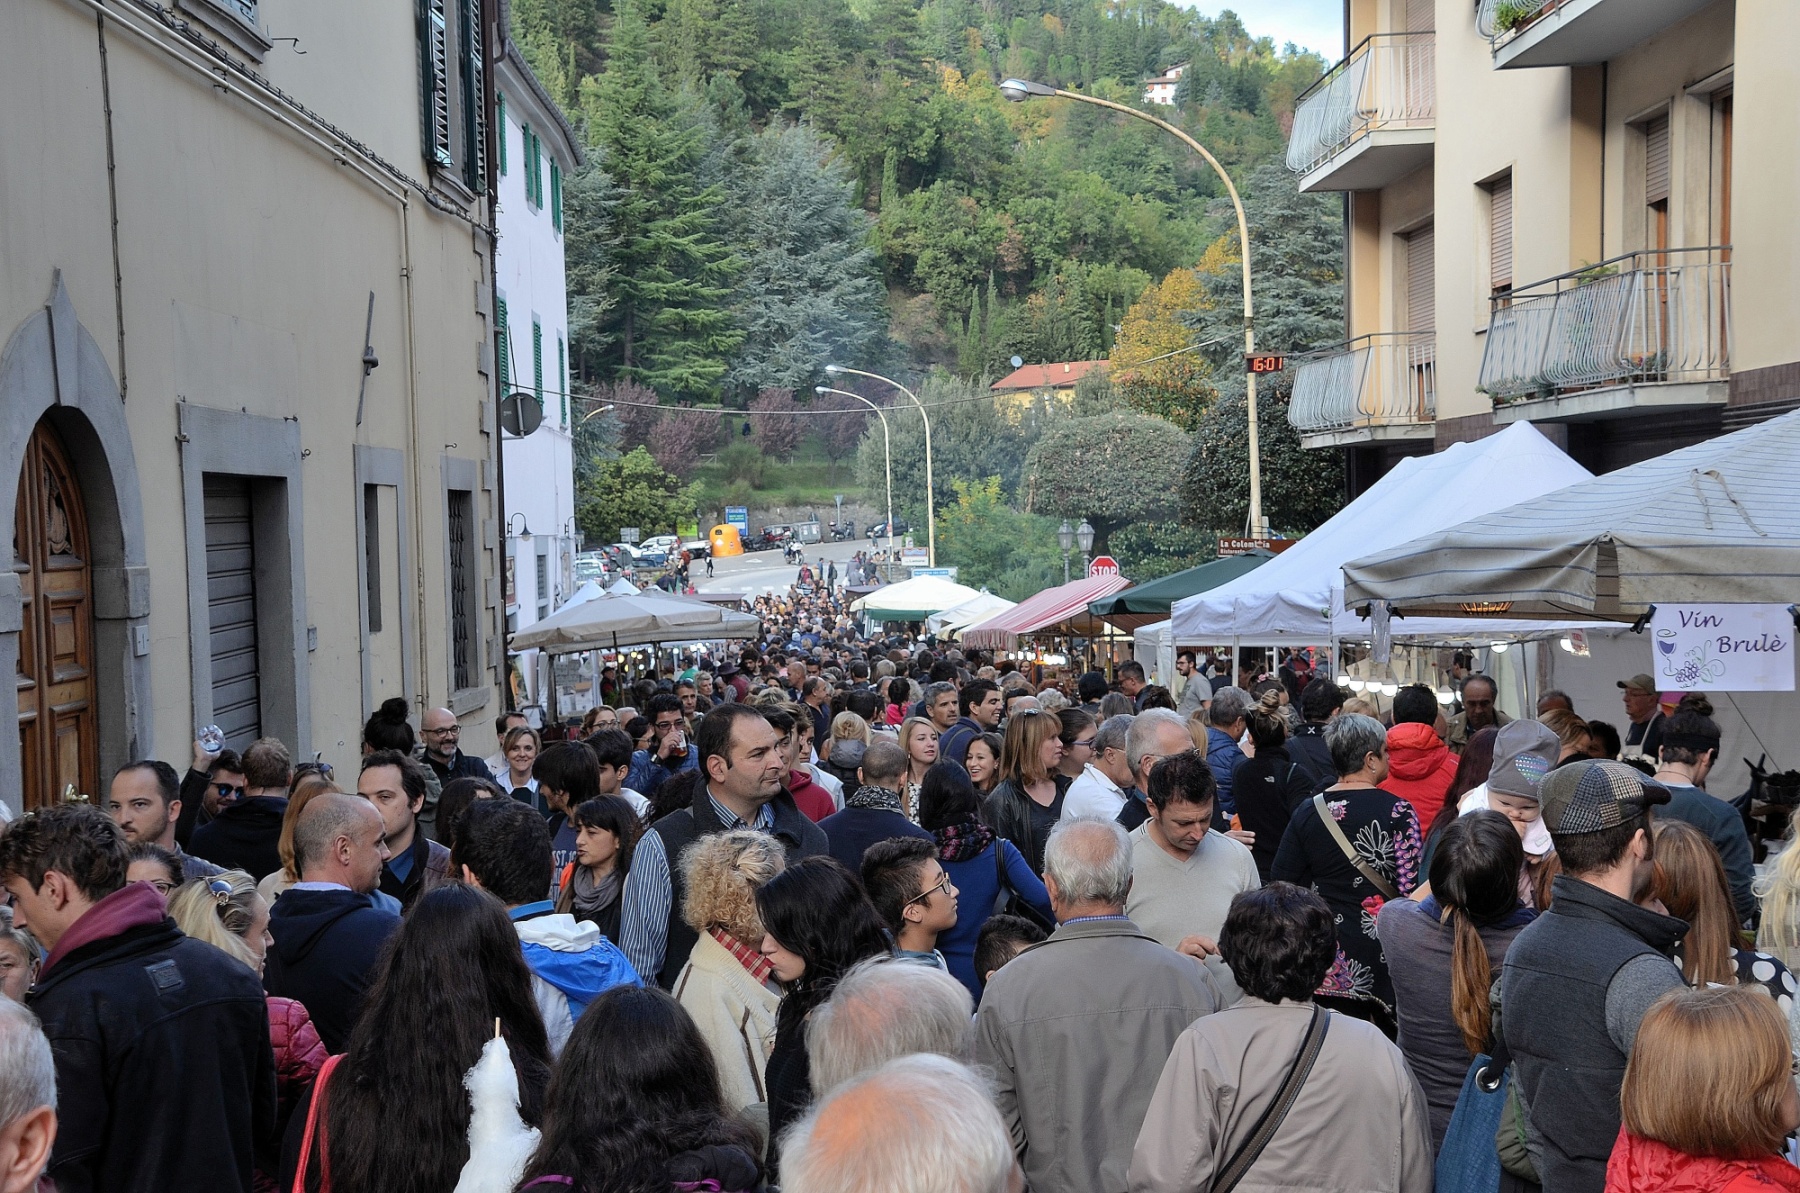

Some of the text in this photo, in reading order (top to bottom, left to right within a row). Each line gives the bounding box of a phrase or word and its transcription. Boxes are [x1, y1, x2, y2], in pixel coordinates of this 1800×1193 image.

[1252, 357, 1283, 371] 16:01
[1220, 540, 1229, 548] La
[1091, 566, 1117, 577] STOP
[1678, 610, 1724, 628] Vin
[1716, 633, 1787, 653] Brulè
